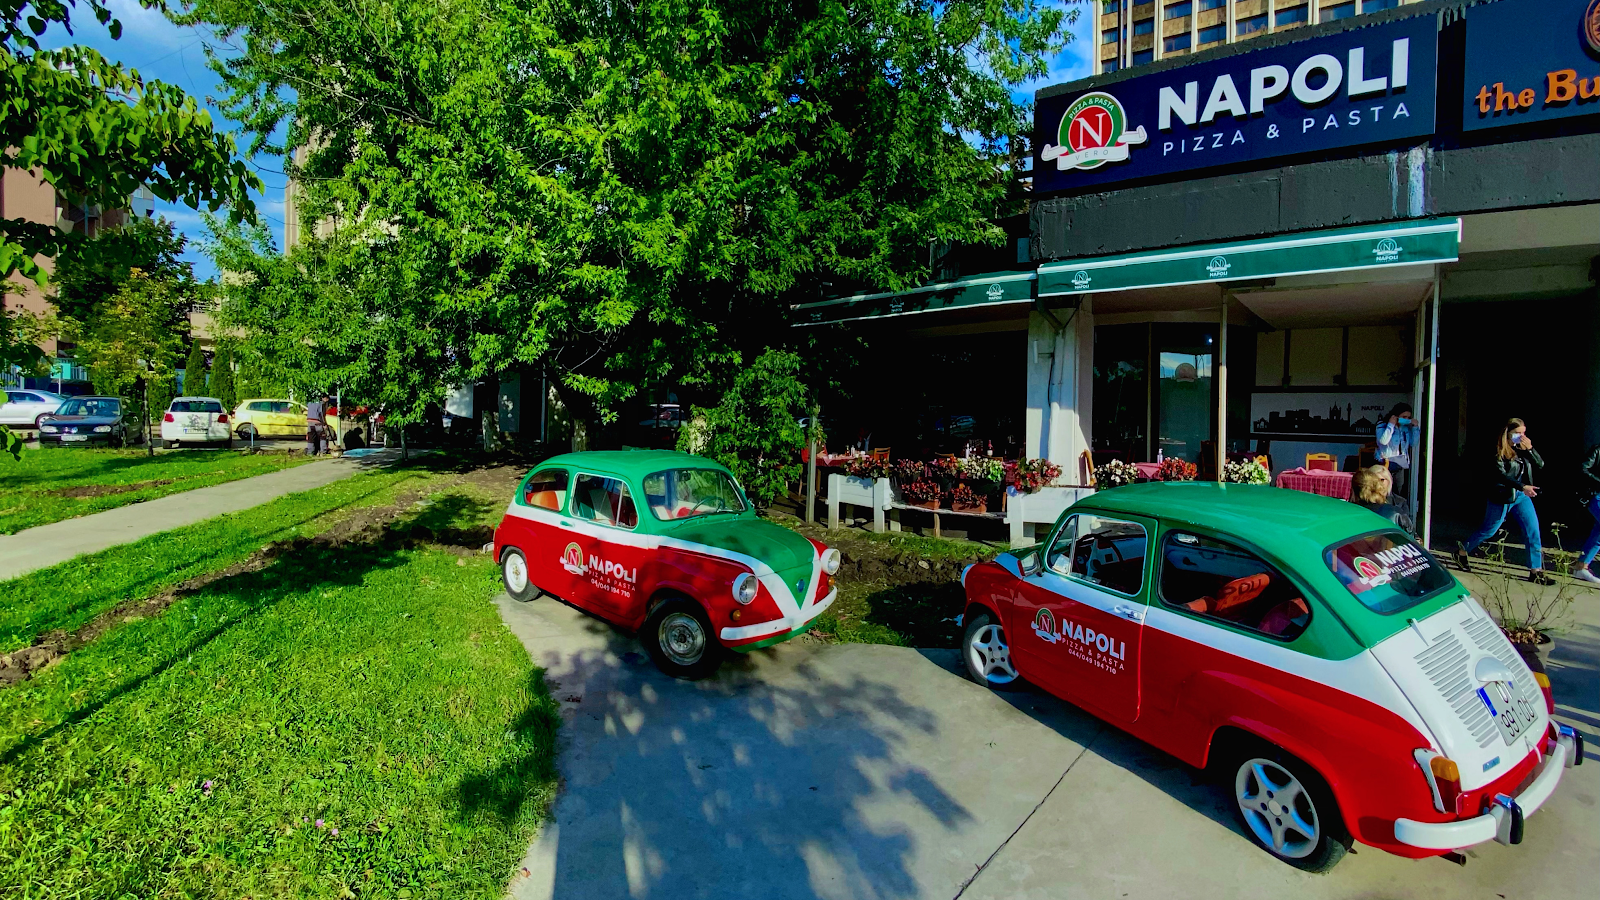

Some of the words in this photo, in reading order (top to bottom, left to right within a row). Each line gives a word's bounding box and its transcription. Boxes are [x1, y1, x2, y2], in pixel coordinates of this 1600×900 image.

[1158, 37, 1410, 130] NAPOLI
[1475, 82, 1535, 113] the
[1068, 101, 1088, 120] PIZZA
[1094, 97, 1115, 112] PASTA
[1074, 112, 1107, 150] N
[1163, 129, 1245, 156] PIZZA
[1266, 124, 1280, 138] &
[1302, 102, 1411, 134] PASTA
[1075, 150, 1109, 161] VERO
[588, 553, 637, 584] NAPOLI
[1374, 543, 1422, 567] NAPOLI
[1061, 637, 1084, 653] PIZZA
[1096, 652, 1125, 671] PASTA
[1062, 618, 1126, 662] NAPOLI
